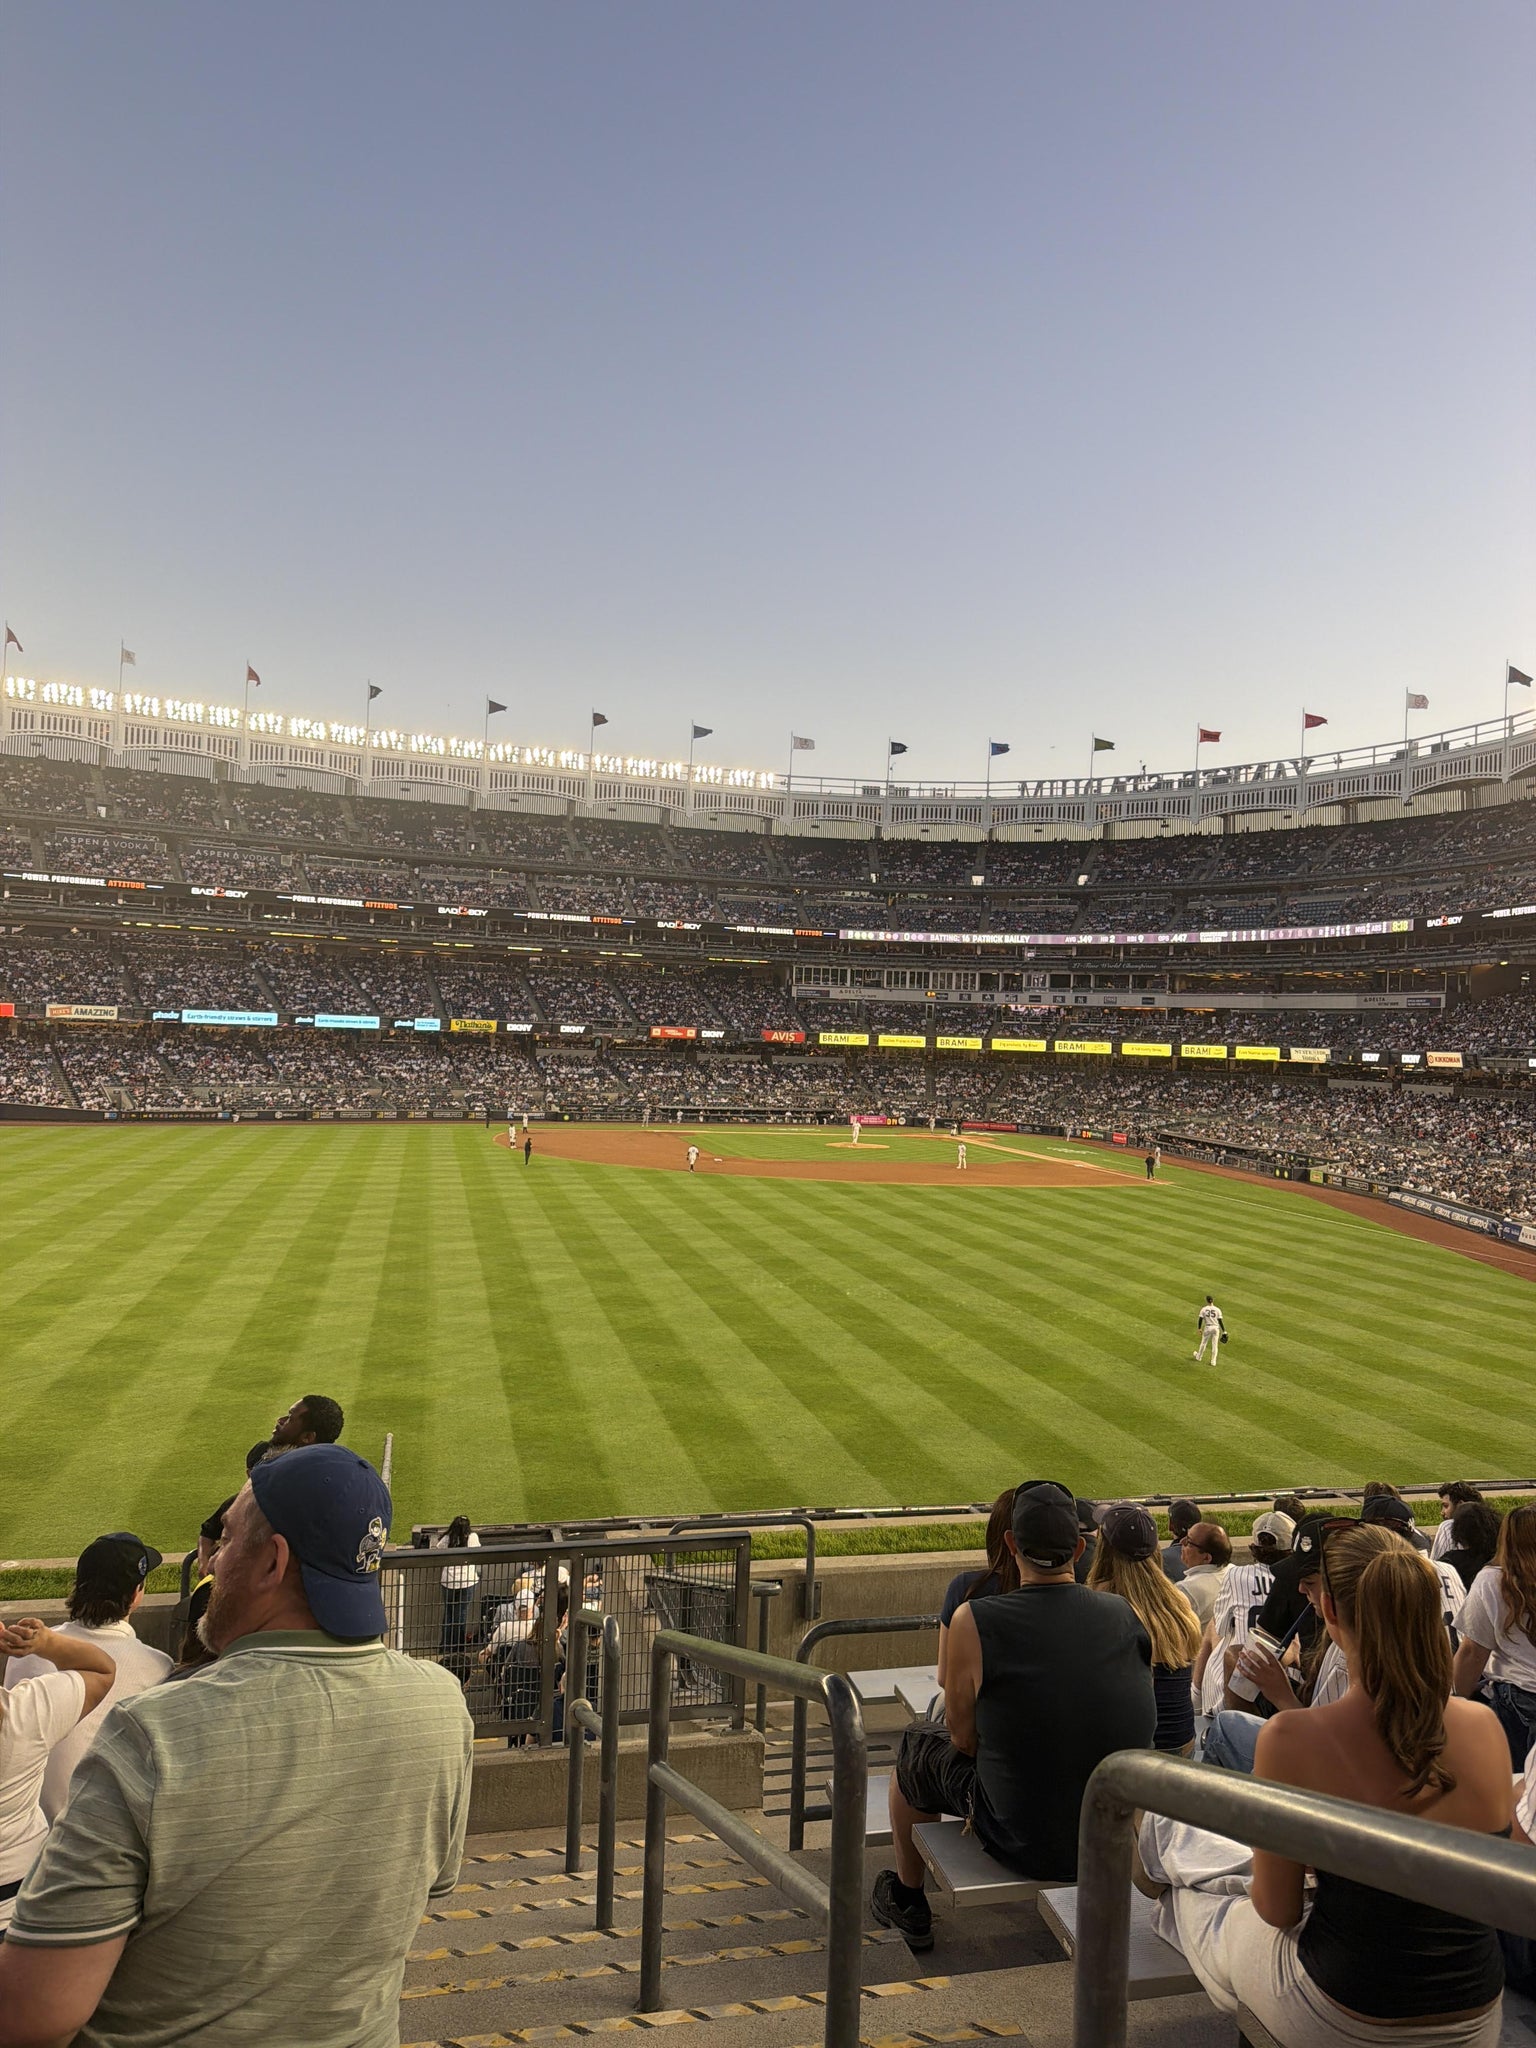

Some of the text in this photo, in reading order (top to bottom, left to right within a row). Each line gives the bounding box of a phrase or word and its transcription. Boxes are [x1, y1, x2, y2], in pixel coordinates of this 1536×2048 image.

[63, 837, 149, 850] ASPEN VODKA
[242, 854, 276, 862] VODKA
[22, 873, 50, 883] POWER.
[51, 876, 106, 887] PERFORMANCE.
[191, 887, 248, 899] BAD BOY
[438, 906, 488, 917] BAD BOY
[1427, 916, 1463, 927] BAD BOY
[930, 934, 961, 942] BATTING:
[972, 935, 1003, 943] PATRICK
[1004, 935, 1031, 944] BAILEY
[1109, 935, 1116, 943] 2
[1138, 935, 1144, 943] 9
[1171, 934, 1187, 943] .447
[1122, 962, 1158, 970] Champions
[74, 1008, 115, 1017] AMAZING
[455, 1020, 492, 1032] Nathan's
[507, 1024, 533, 1032] DKNY
[560, 1025, 585, 1033] DKNY
[701, 1030, 725, 1038] DKNY
[771, 1032, 795, 1041] AVIS
[822, 1034, 849, 1043] BRAMI
[940, 1039, 967, 1047] BRAMI
[1058, 1043, 1085, 1051] BRAMI
[1184, 1047, 1211, 1056] BRAMI
[1435, 1055, 1460, 1063] KIKKOMAN
[1205, 1309, 1216, 1318] 35
[1252, 1575, 1273, 1596] JU
